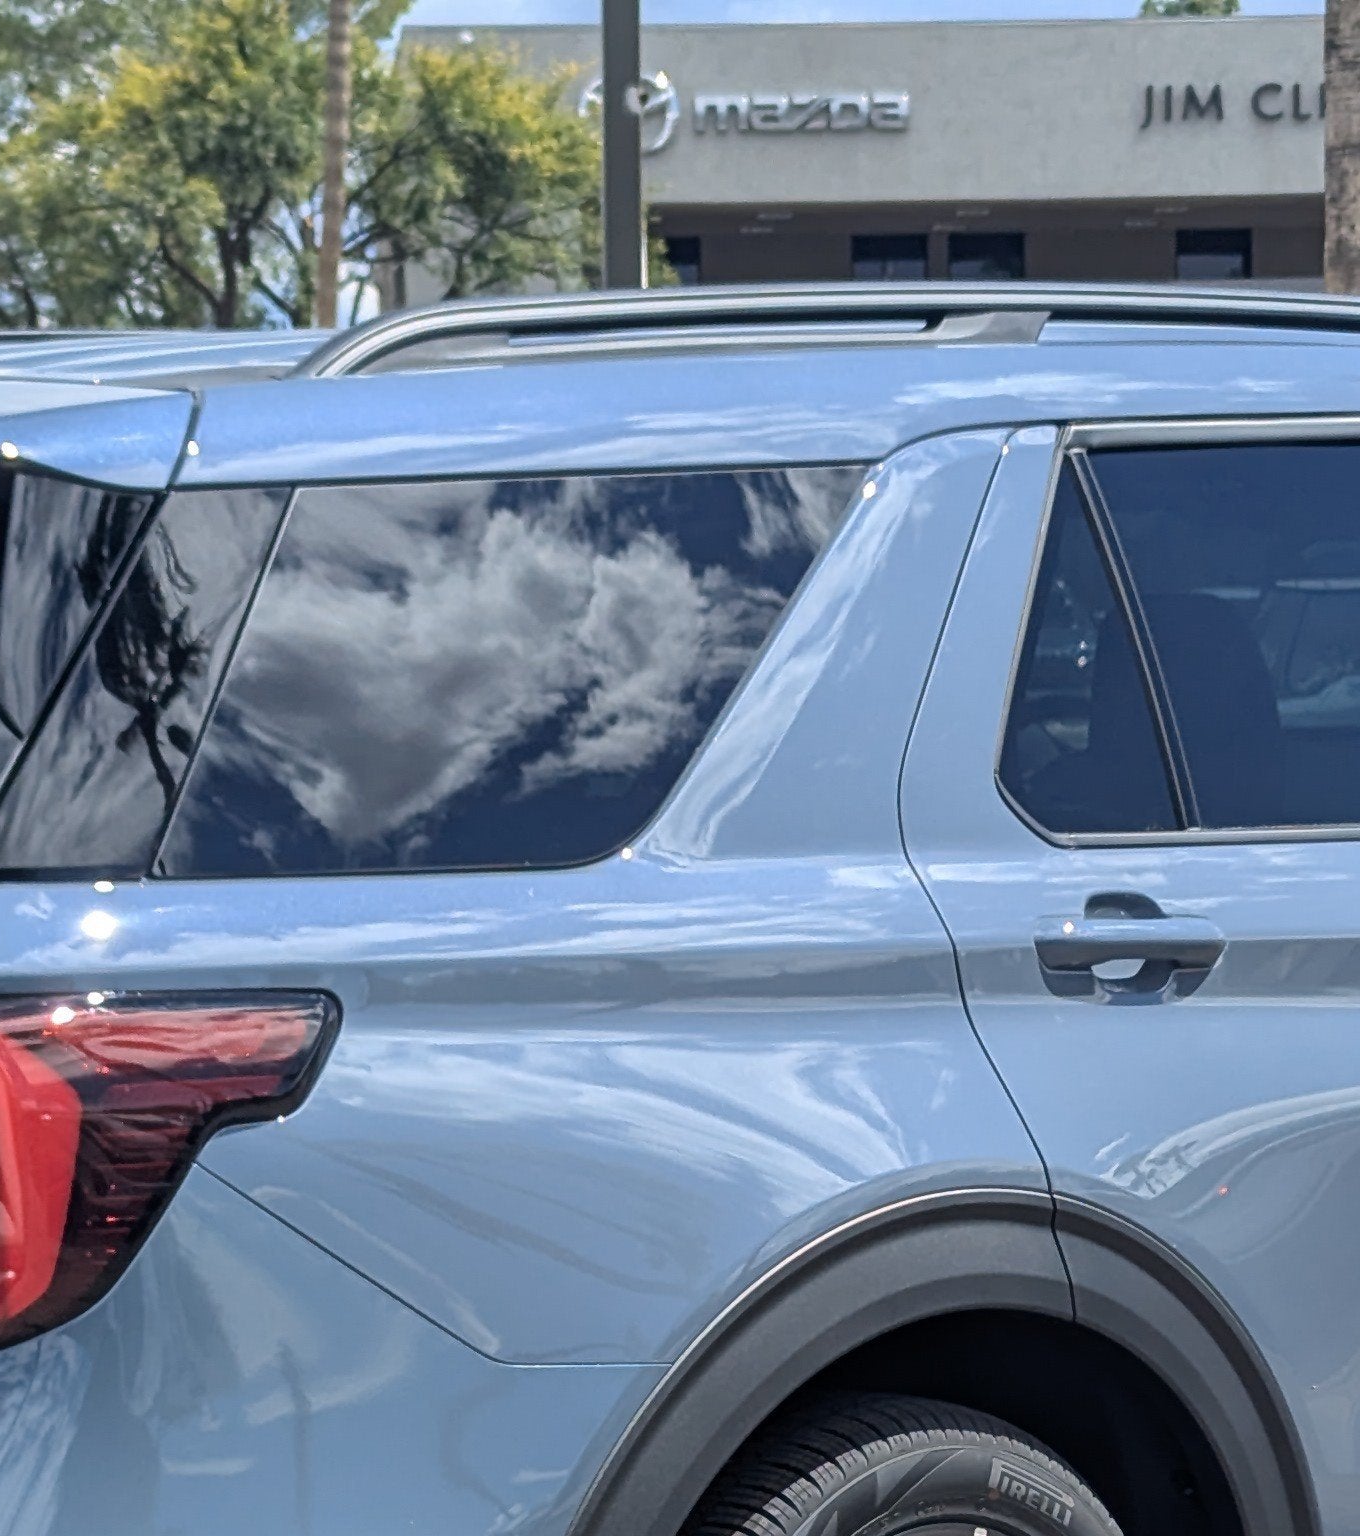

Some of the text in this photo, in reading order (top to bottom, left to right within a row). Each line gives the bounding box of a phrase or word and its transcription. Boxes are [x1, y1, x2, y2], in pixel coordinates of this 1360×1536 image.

[693, 93, 909, 132] mazda
[1140, 83, 1224, 128] JIM
[988, 1457, 1076, 1528] PIRELLI
